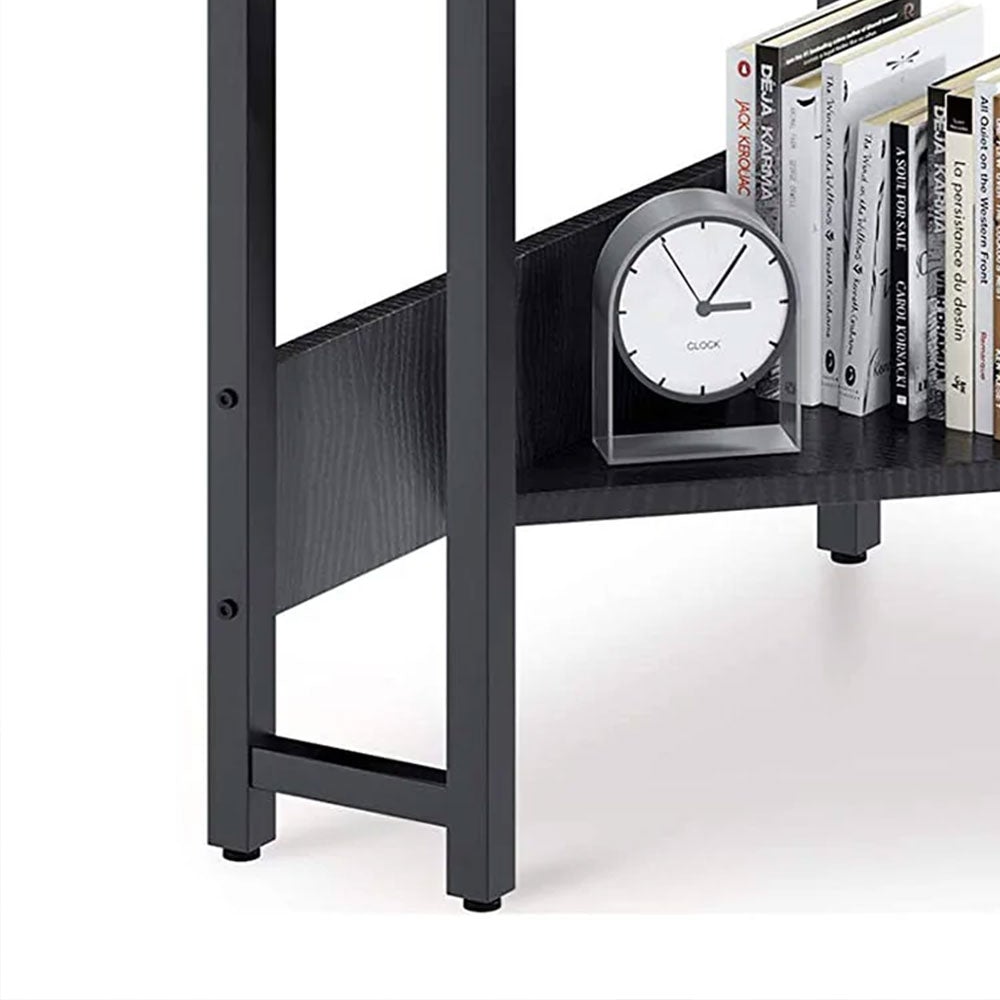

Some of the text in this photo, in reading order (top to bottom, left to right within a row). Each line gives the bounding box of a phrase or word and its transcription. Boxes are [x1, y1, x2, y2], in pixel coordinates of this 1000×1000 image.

[826, 76, 834, 94] The
[826, 99, 835, 132] Wind
[981, 96, 989, 112] All
[734, 99, 751, 197] JACK KEROUAC
[826, 137, 833, 150] in
[863, 134, 872, 149] The
[980, 116, 989, 150] Quiet
[760, 125, 774, 201] KARMA
[826, 153, 834, 171] the
[862, 153, 872, 183] Wind
[981, 153, 987, 170] on
[933, 163, 946, 233] KARMA
[981, 173, 989, 193] the
[826, 175, 835, 226] Willows
[858, 199, 867, 215] the
[855, 215, 867, 260] Willows
[980, 197, 989, 247] Western
[896, 146, 907, 388] A SOUL FOR SALE CAROL KORNACKI
[951, 160, 967, 342] La persistance du destin
[980, 251, 989, 284] Front
[686, 339, 721, 351] CLOCK
[936, 312, 946, 380] DHAMIJA
